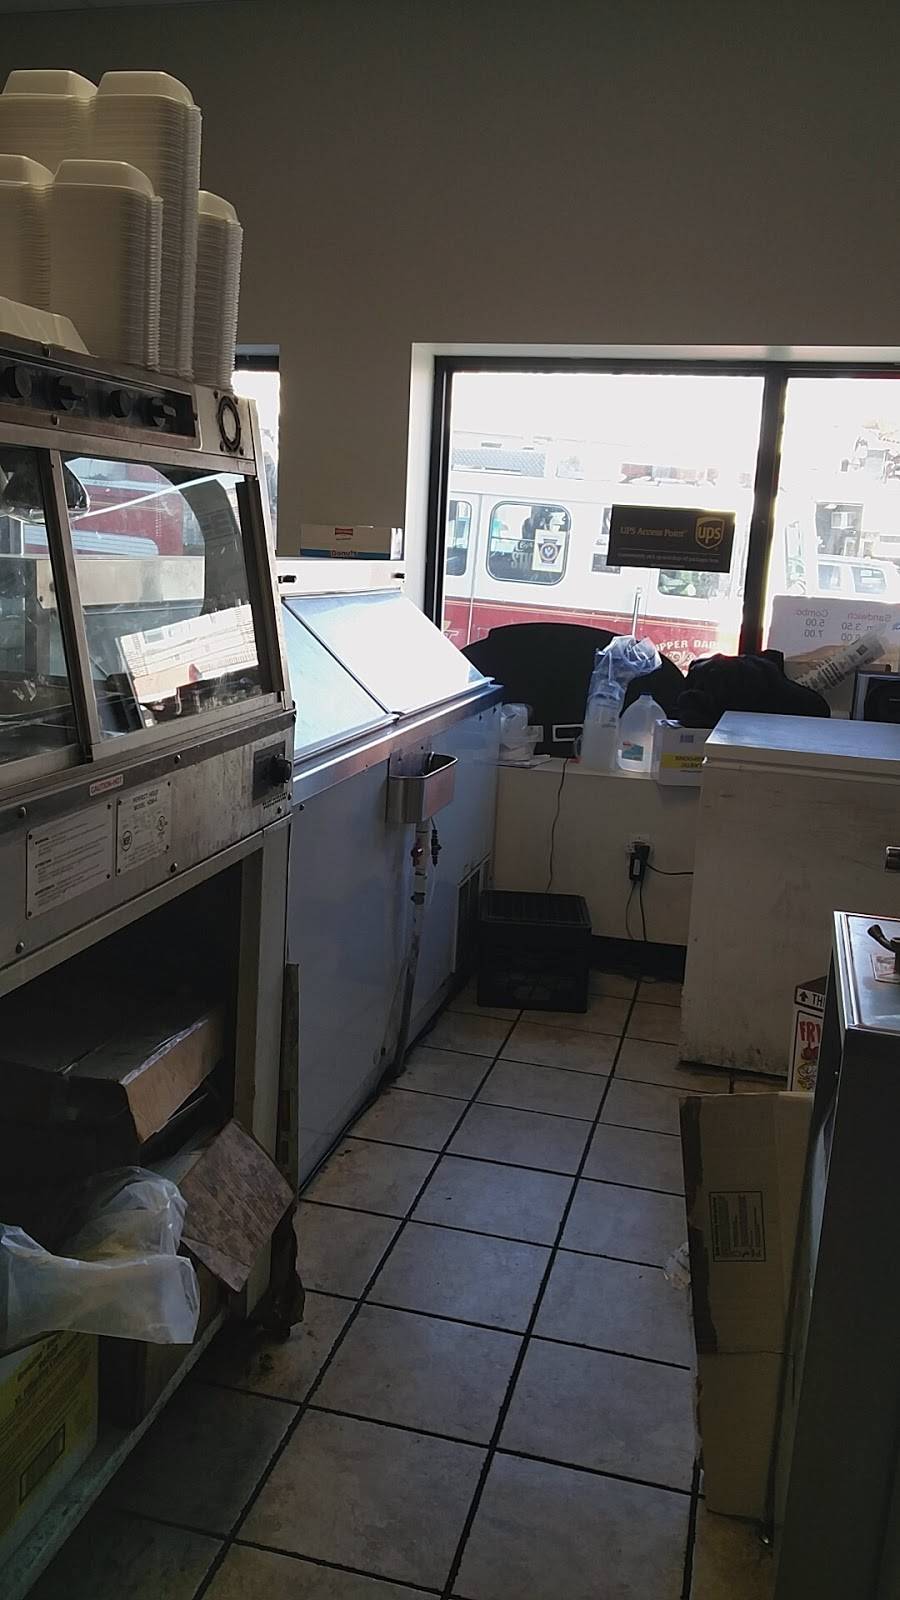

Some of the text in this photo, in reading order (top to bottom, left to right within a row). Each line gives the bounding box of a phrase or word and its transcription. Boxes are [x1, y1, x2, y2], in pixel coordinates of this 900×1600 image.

[620, 526, 685, 538] UPS Access Point
[697, 525, 721, 544] ups
